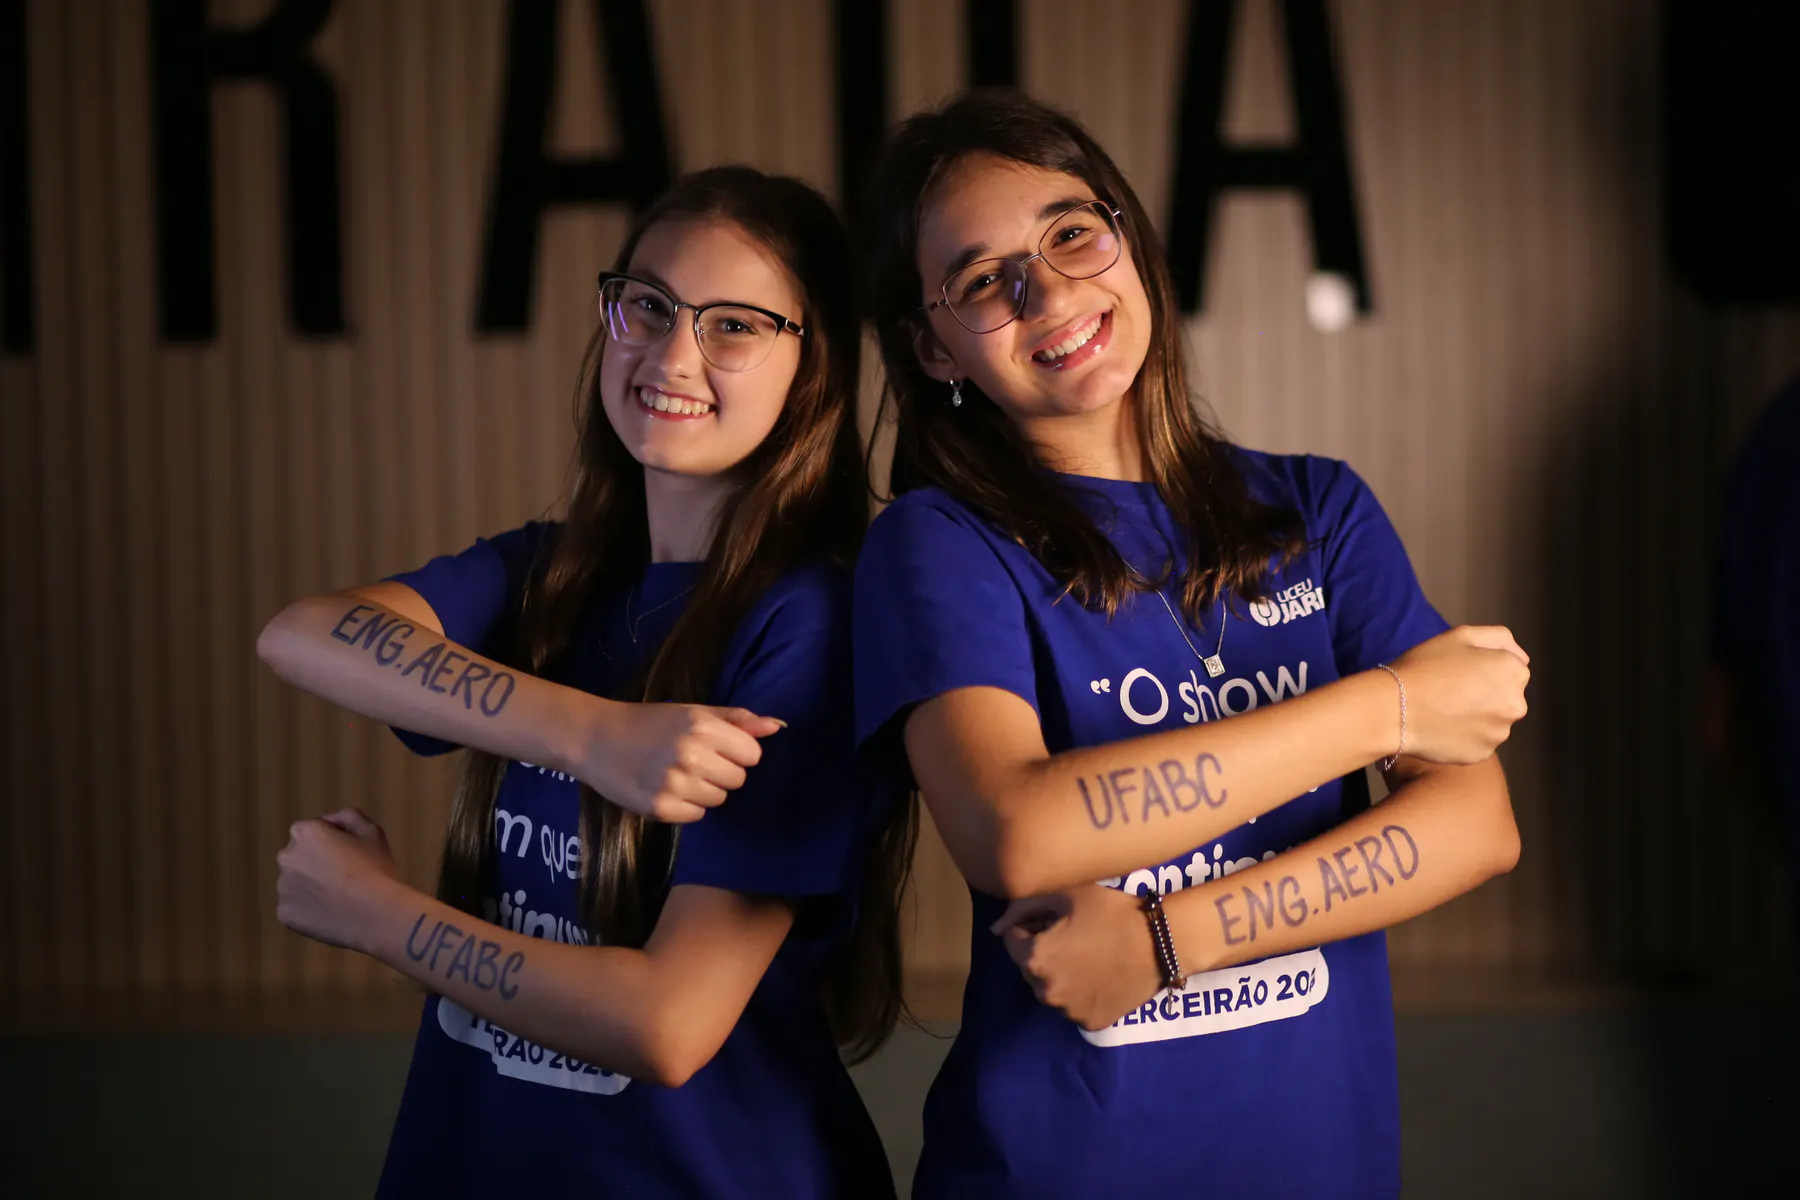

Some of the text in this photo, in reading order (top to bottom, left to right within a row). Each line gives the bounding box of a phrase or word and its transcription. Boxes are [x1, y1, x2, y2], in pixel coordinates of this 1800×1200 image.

[1276, 578, 1314, 603] LICEU
[330, 604, 516, 718] ENG.AERO
[1178, 661, 1308, 724] show
[1076, 752, 1228, 831] UFABC
[540, 824, 583, 884] que
[406, 912, 526, 1000] UFABC
